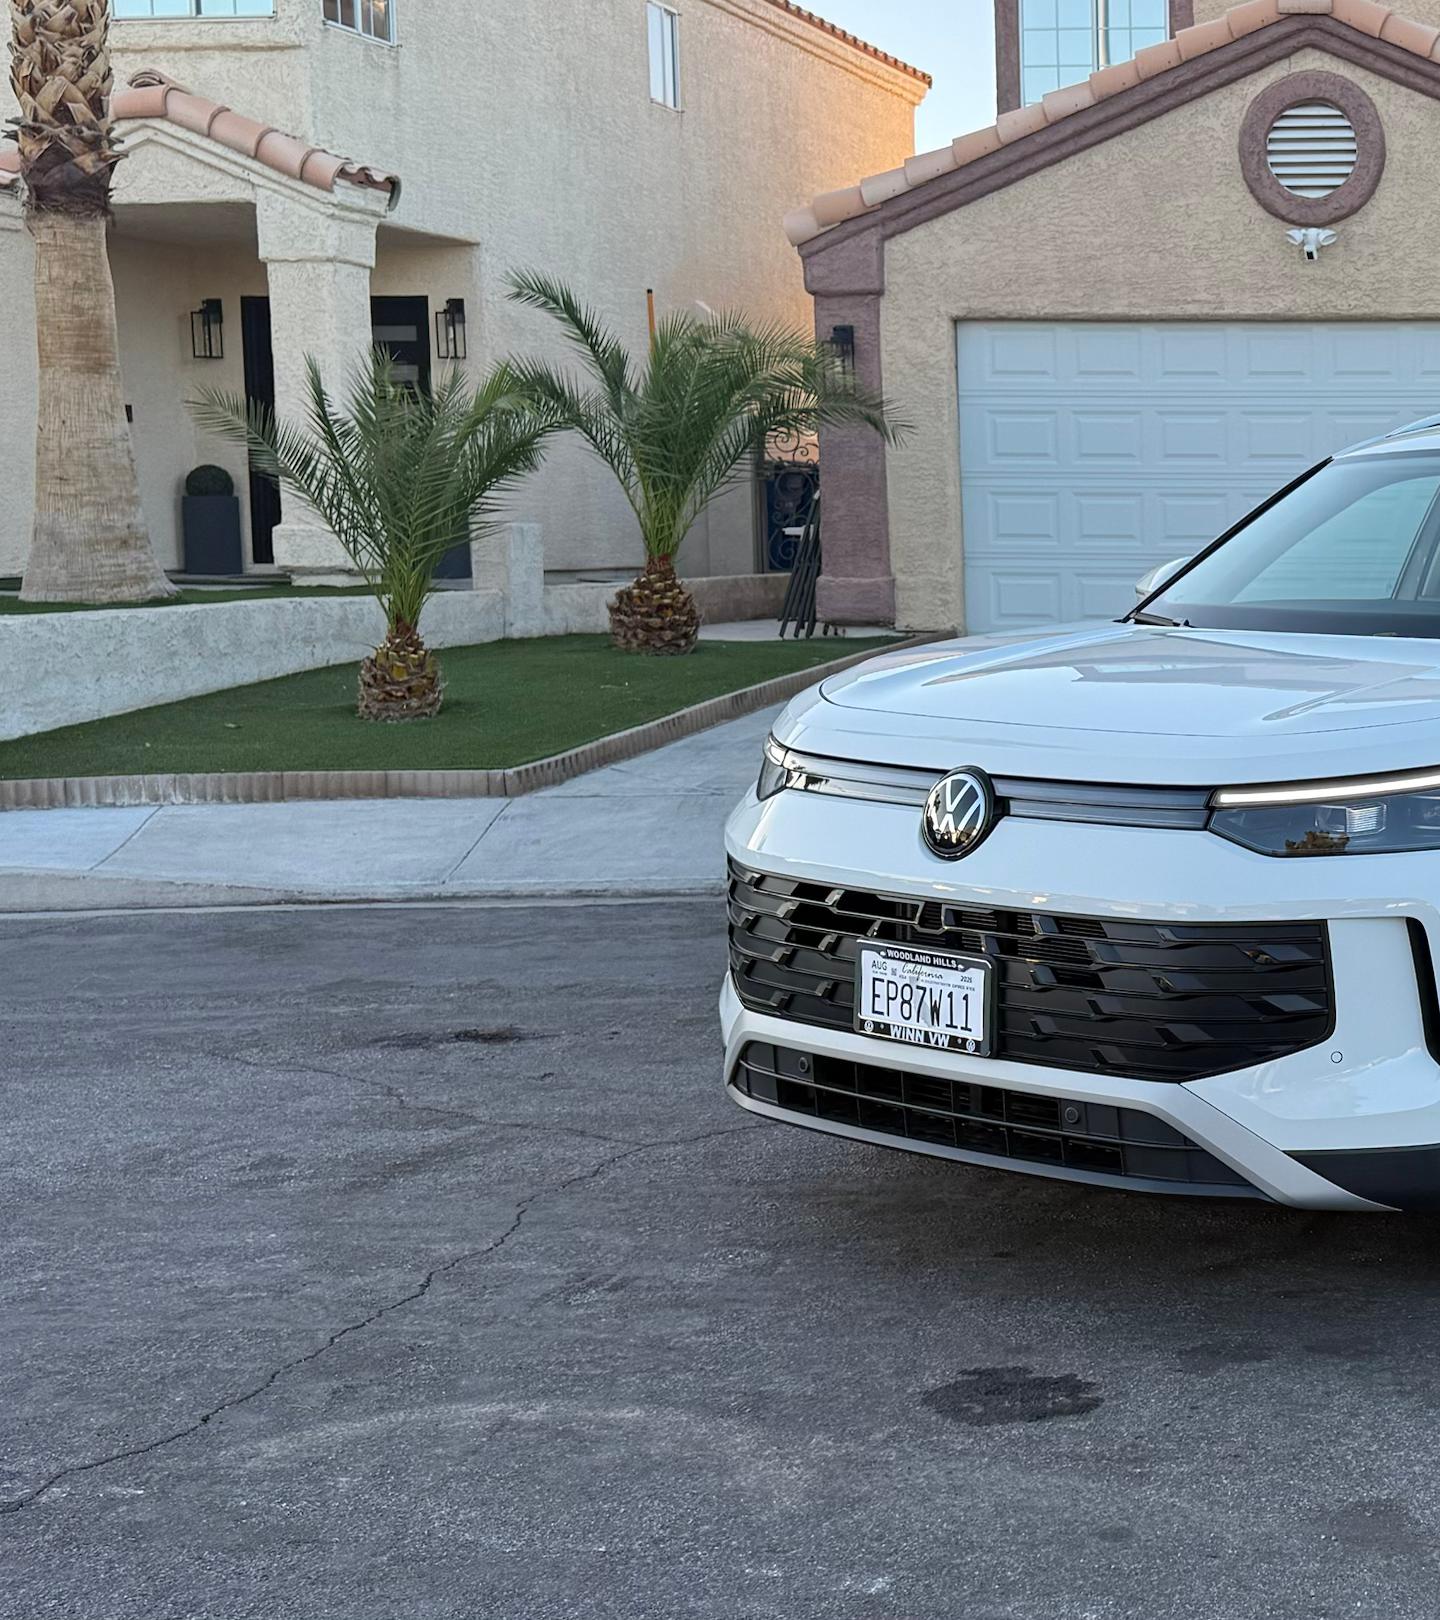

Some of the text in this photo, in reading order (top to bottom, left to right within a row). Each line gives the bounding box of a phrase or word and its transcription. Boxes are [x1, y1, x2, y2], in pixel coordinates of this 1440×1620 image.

[925, 773, 985, 849] VW
[871, 960, 888, 971] AUG
[886, 949, 957, 969] WOODLAND HILLS
[901, 962, 943, 981] California
[871, 977, 973, 1032] EP87W11
[889, 1024, 925, 1044] WINN
[928, 1029, 950, 1048] VW
